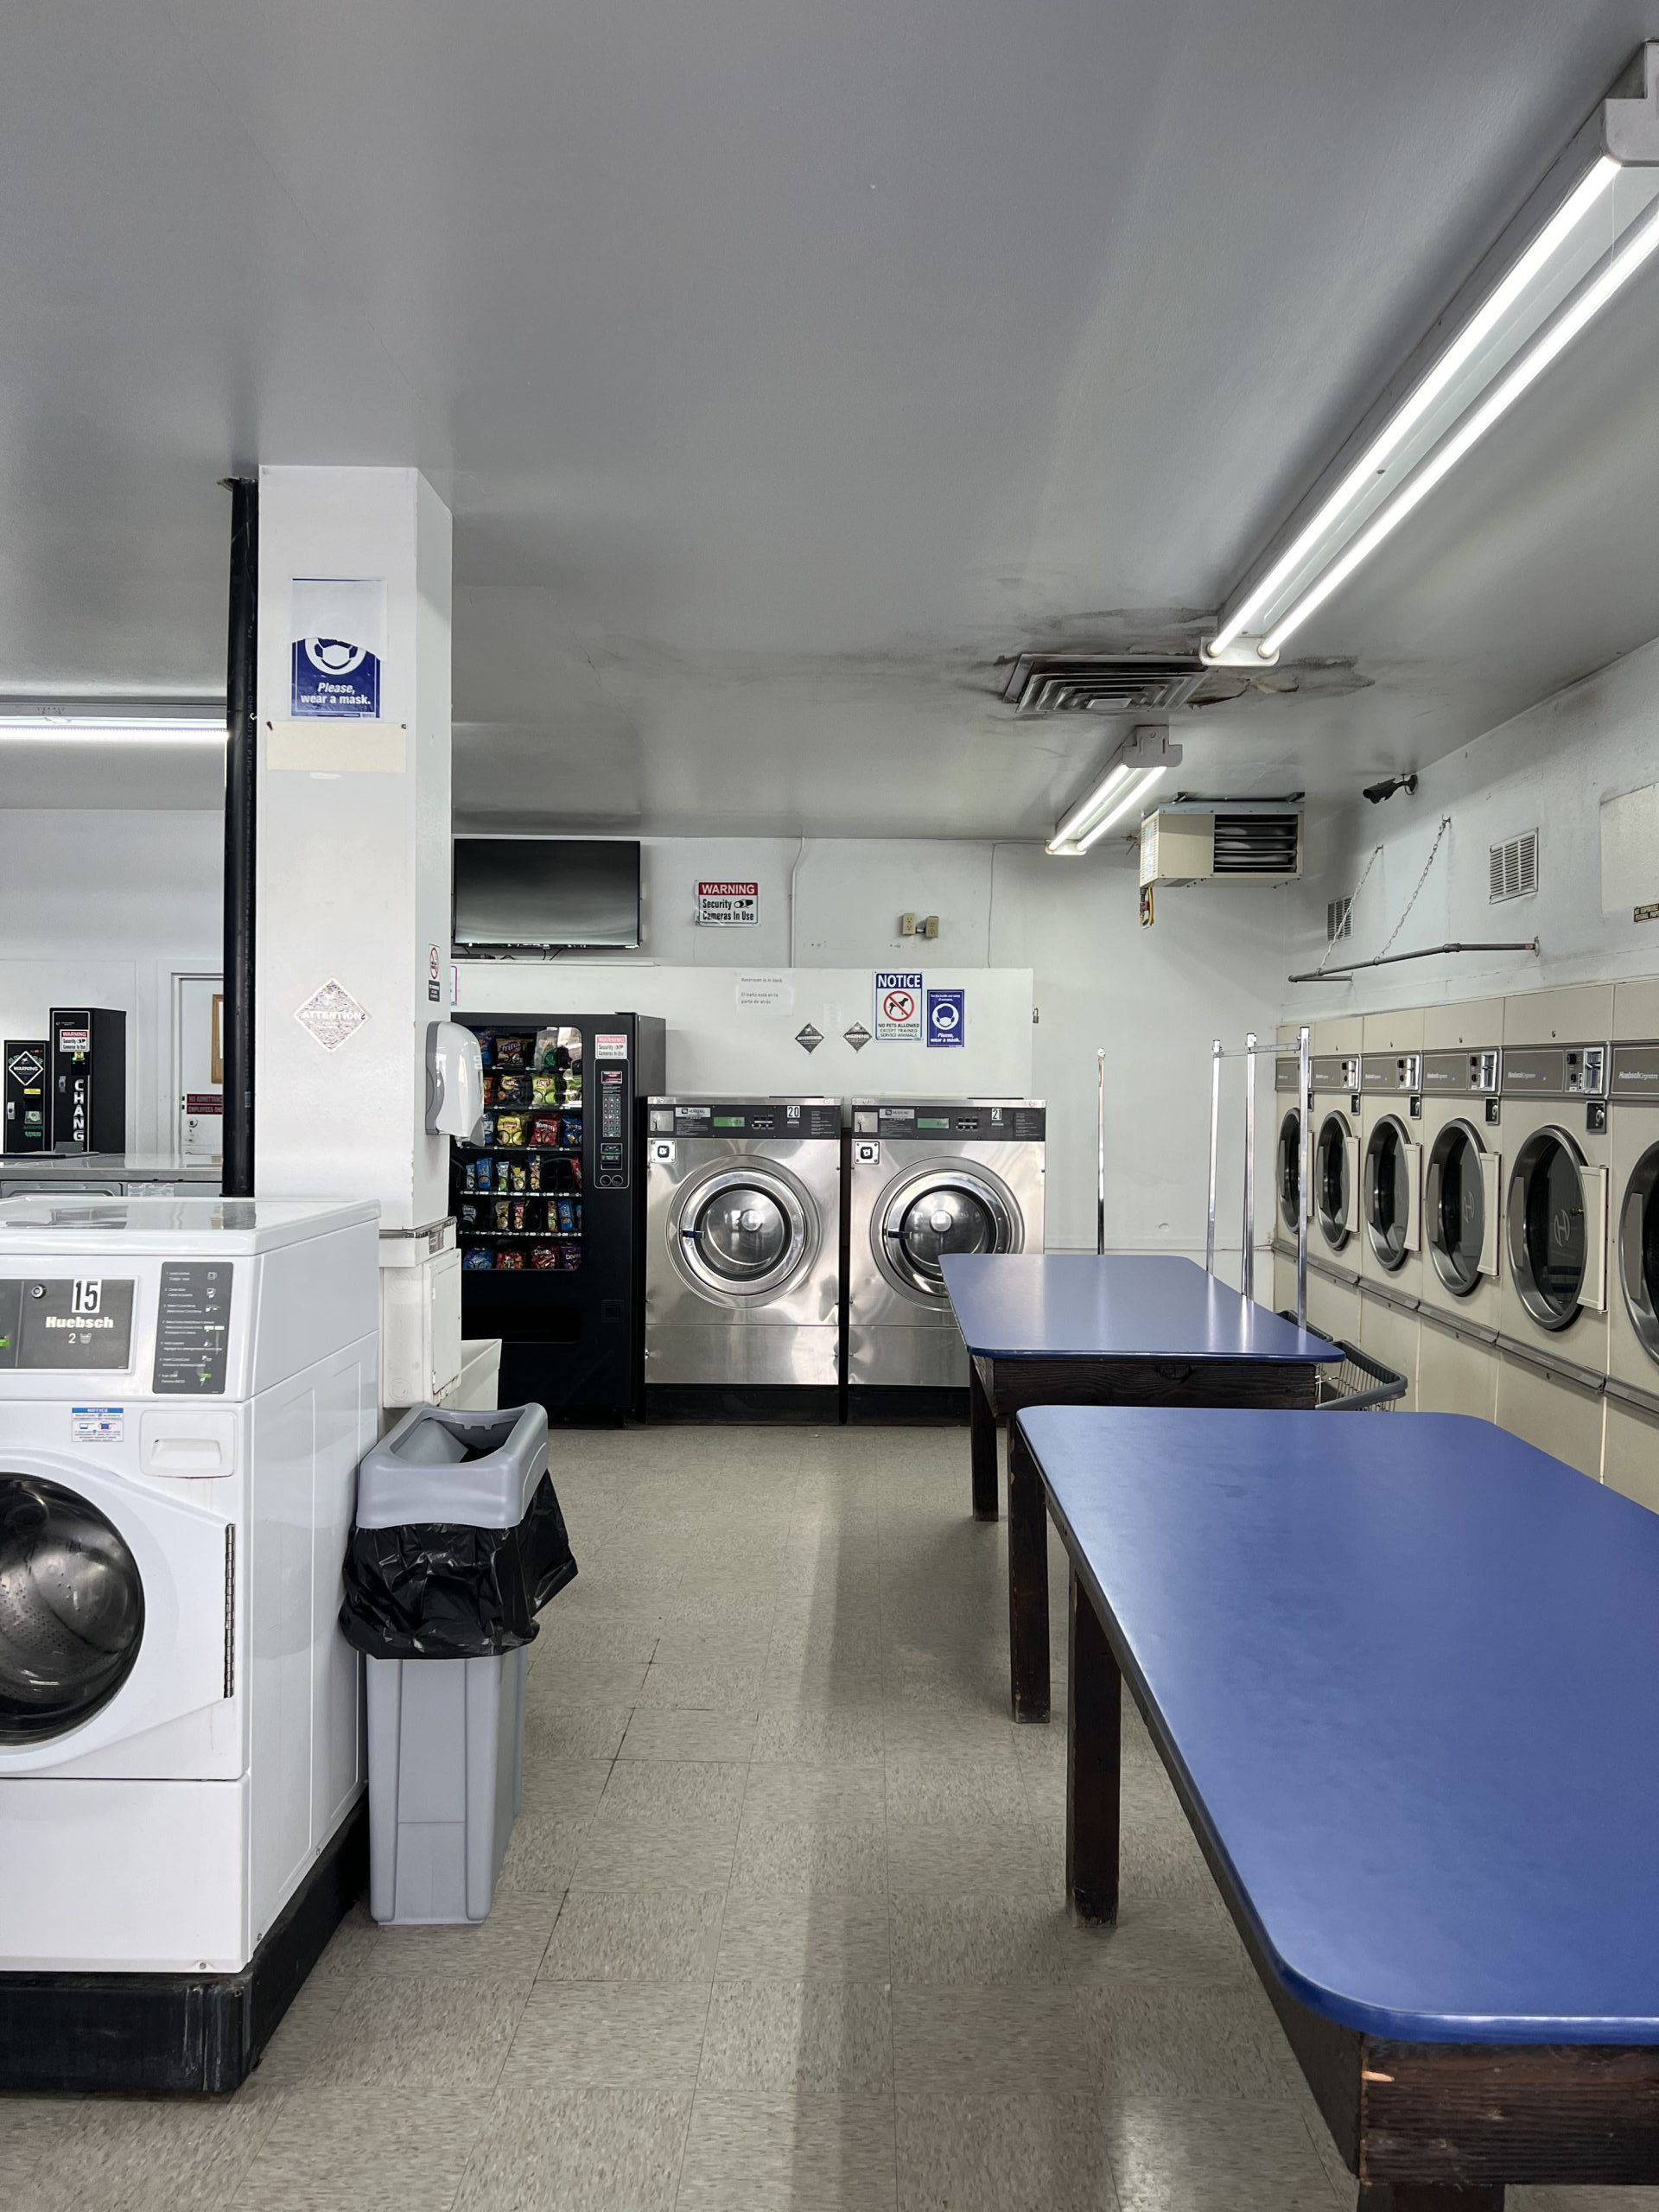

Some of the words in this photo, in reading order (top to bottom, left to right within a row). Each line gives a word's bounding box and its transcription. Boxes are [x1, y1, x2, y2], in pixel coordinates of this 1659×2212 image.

[317, 682, 355, 695] Please,
[300, 695, 327, 704] wear
[329, 696, 337, 704] a
[340, 695, 372, 705] mask.
[702, 884, 755, 894] WARNING
[702, 899, 732, 910] Security
[702, 911, 732, 921] Cameras
[734, 911, 740, 920] In
[741, 911, 754, 921] Use
[878, 975, 921, 988] NOTICE
[302, 1011, 362, 1020] ATTENTION
[73, 1079, 85, 1141] CHANG
[788, 1107, 799, 1117] 20
[992, 1109, 1001, 1120] 21
[74, 1281, 99, 1311] 15
[45, 1316, 114, 1328] Huebsch
[68, 1333, 76, 1344] 2
